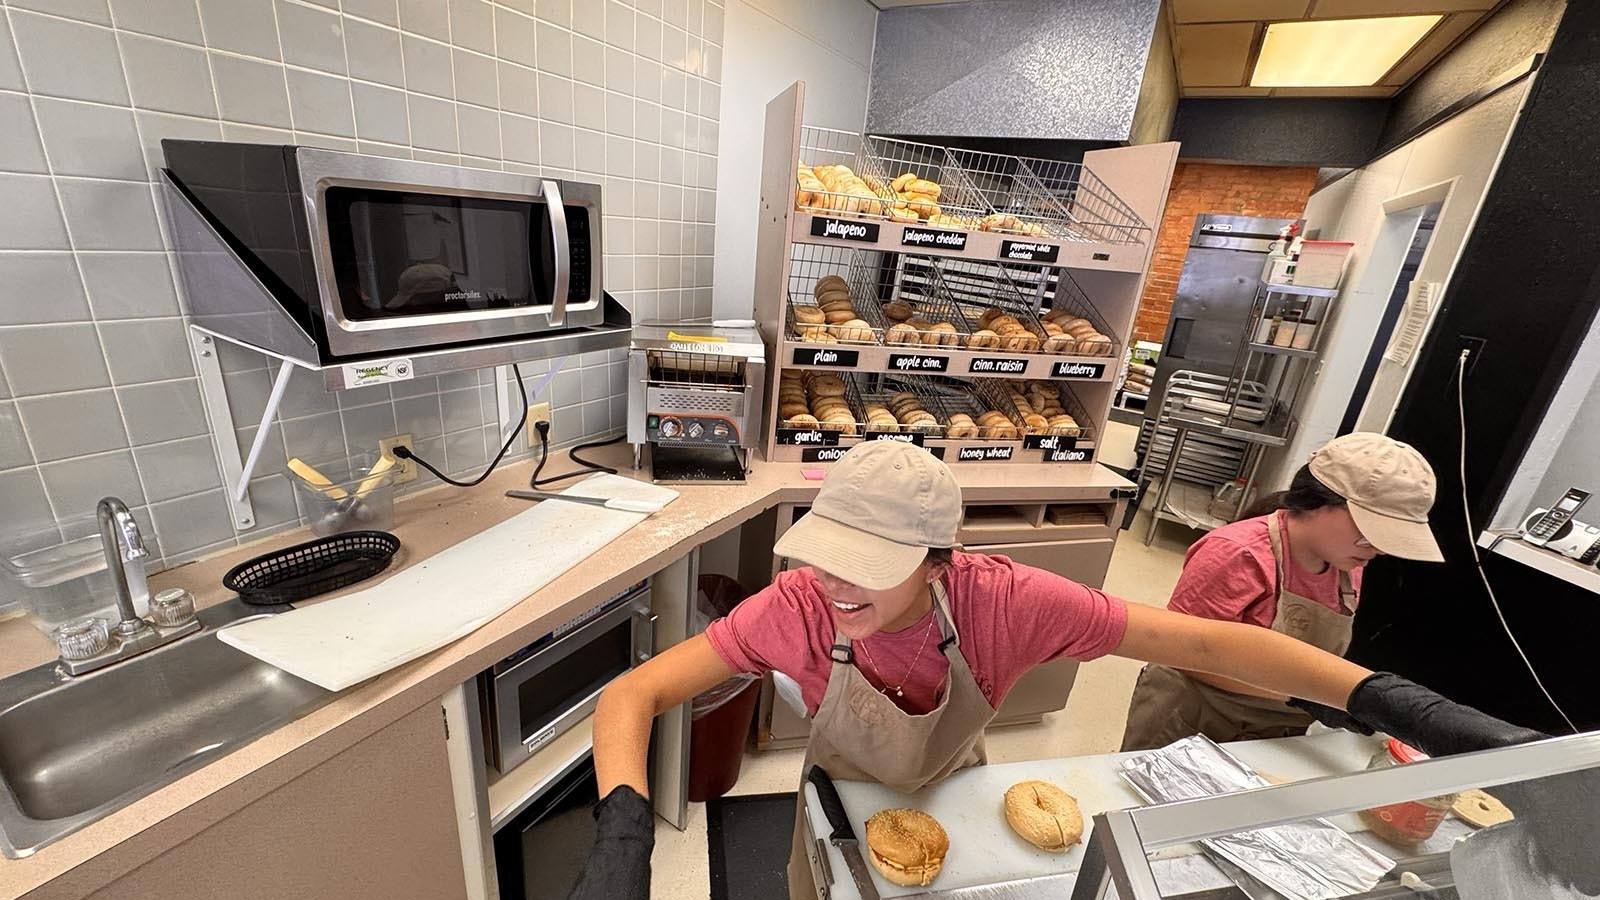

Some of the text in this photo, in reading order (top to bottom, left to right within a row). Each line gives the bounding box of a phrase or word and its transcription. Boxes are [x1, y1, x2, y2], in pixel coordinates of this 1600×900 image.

[823, 220, 866, 239] jalapeno
[903, 230, 965, 246] jalapeno cheddar
[813, 350, 838, 365] plain
[896, 355, 942, 370] apple cinn.
[356, 365, 389, 374] REGENCY
[1059, 362, 1096, 377] blueberry
[794, 429, 822, 444] garlic
[877, 434, 914, 443] sese
[1039, 436, 1059, 450] salt
[960, 447, 1011, 461] honey wheat
[1051, 449, 1085, 461] italiano
